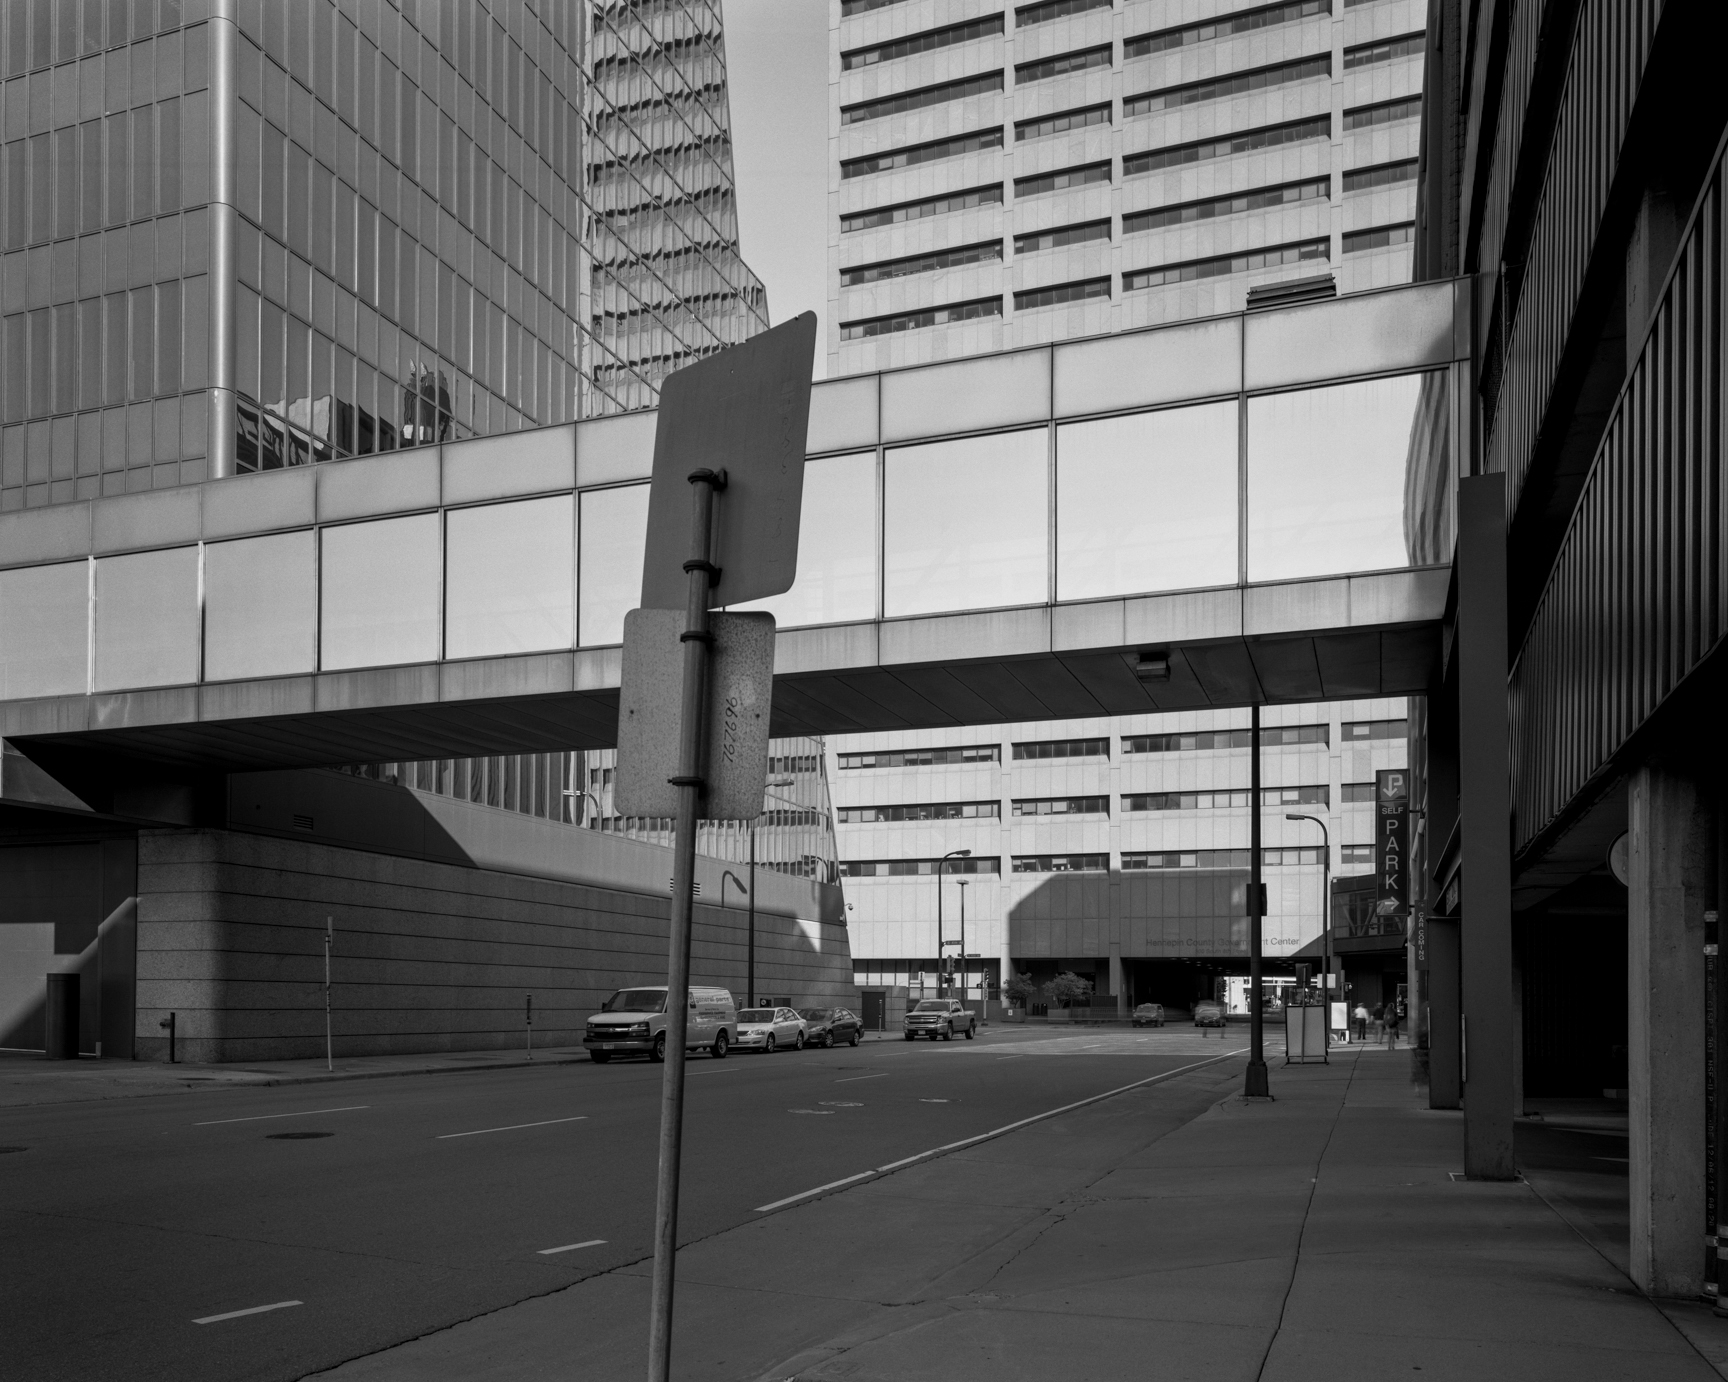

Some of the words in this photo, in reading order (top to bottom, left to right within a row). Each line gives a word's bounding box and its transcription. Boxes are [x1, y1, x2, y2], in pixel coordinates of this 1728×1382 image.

[722, 697, 738, 763] 767696
[1381, 807, 1404, 815] SELF
[1385, 819, 1400, 890] PARK
[1146, 938, 1184, 948] Hennepin
[1186, 938, 1215, 948] County
[1217, 937, 1269, 947] Governnt
[1270, 937, 1300, 946] Center
